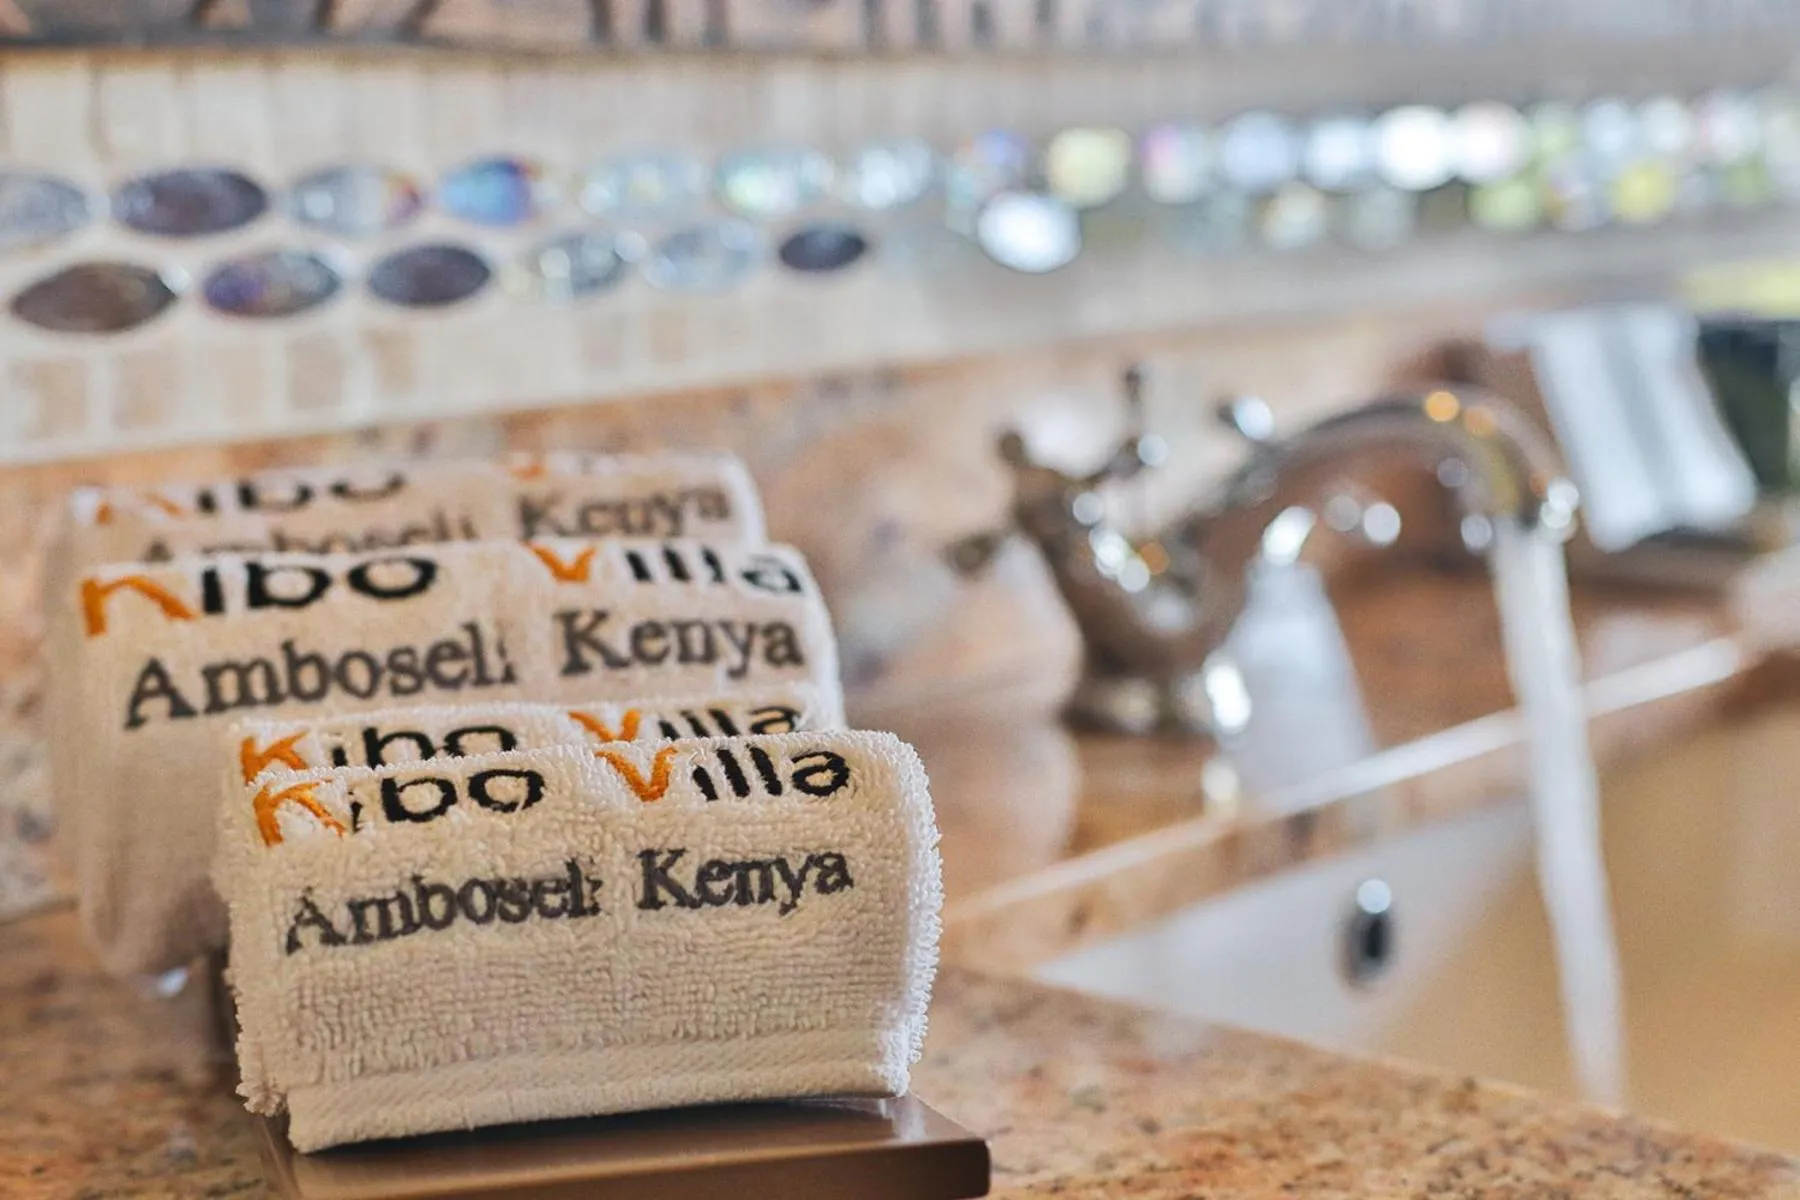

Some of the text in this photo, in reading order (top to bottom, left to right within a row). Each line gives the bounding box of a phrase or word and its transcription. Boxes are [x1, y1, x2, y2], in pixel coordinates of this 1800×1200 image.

[123, 610, 804, 731] Amboseli Kenya
[252, 743, 851, 848] Kibo Villa
[285, 847, 854, 956] Amboseli Kenya
